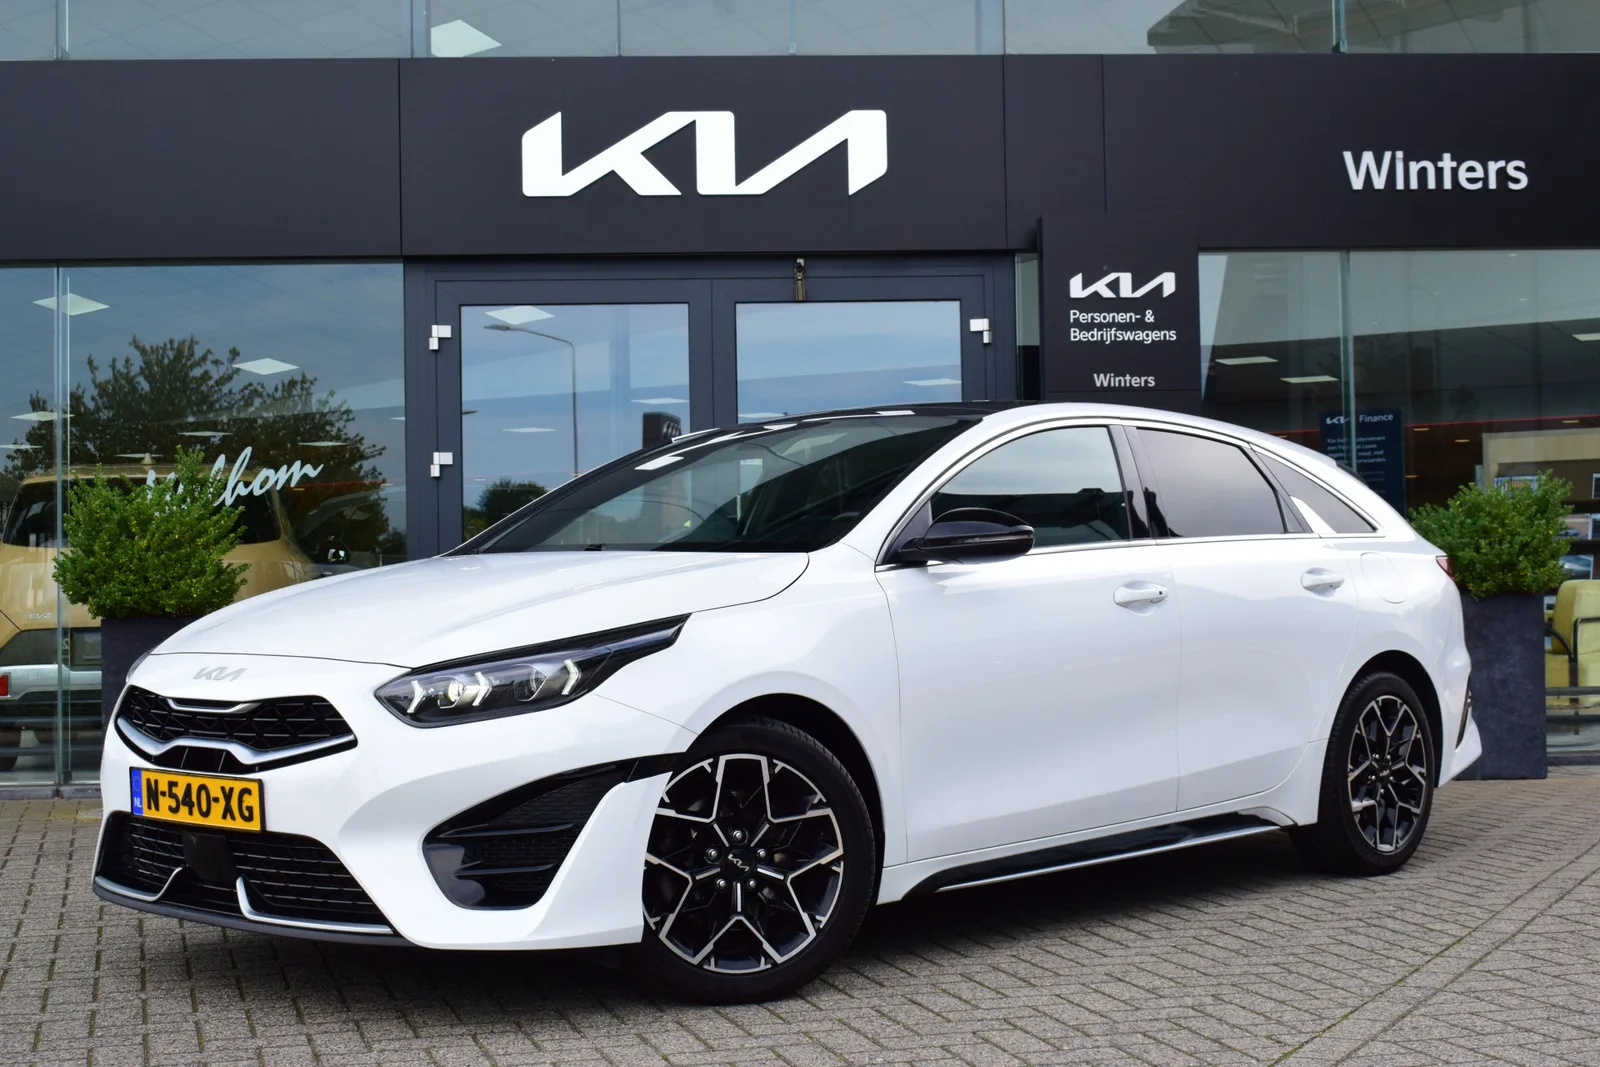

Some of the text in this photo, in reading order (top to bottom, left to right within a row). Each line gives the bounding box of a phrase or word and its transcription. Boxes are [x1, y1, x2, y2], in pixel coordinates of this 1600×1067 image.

[522, 109, 888, 197] KIA
[1342, 150, 1529, 190] Winters
[1069, 271, 1176, 298] KIA
[1069, 309, 1155, 323] Personen- &
[1070, 327, 1177, 344] Bedrijfswagens
[1093, 373, 1156, 387] Winters
[1359, 414, 1393, 423] Finance
[192, 665, 248, 682] KIA
[133, 777, 255, 823] NL N-540-XG
